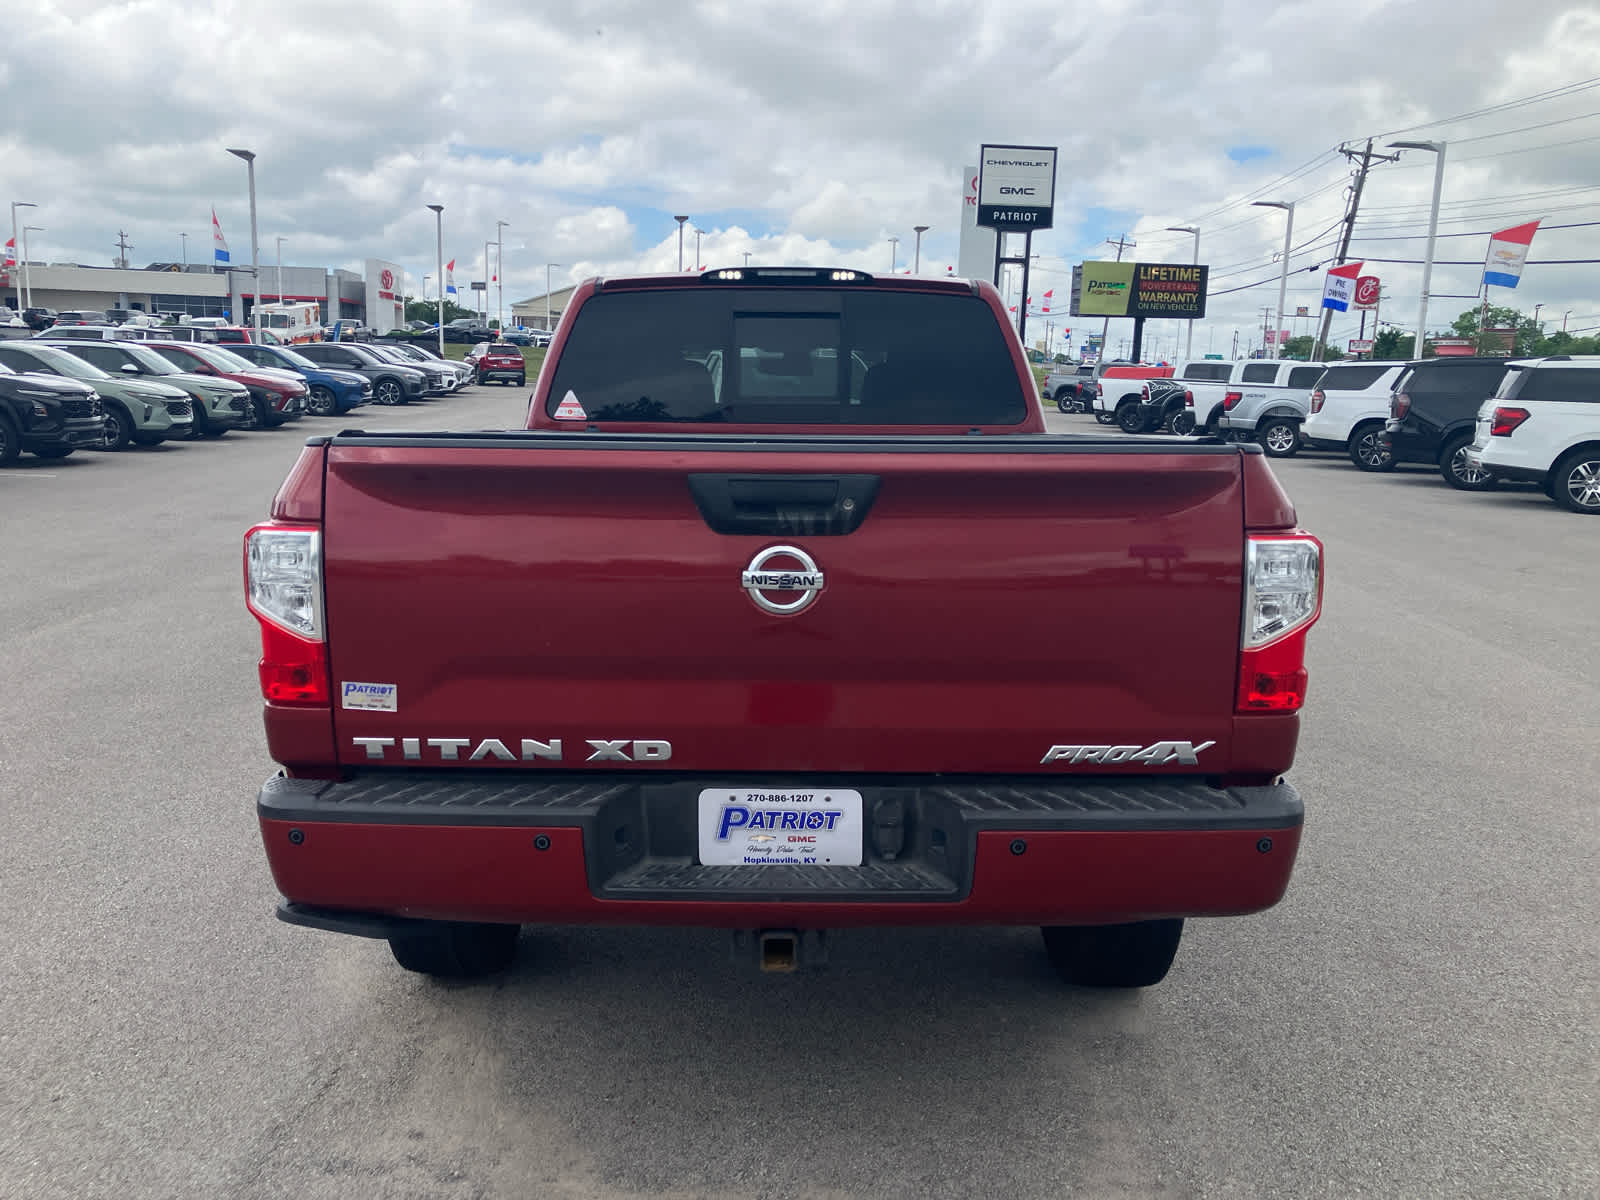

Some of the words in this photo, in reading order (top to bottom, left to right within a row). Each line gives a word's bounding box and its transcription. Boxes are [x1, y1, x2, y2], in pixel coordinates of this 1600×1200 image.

[986, 159, 1049, 167] CHEVROLET
[999, 187, 1036, 195] GMC
[993, 211, 1038, 221] PATRIOT
[1140, 266, 1201, 281] LIFETIME
[1138, 291, 1199, 303] WARRANTY
[1137, 302, 1150, 310] ON
[1150, 302, 1167, 310] NEW
[1167, 303, 1199, 311] VEHICLES
[751, 575, 816, 586] NISSAN
[344, 683, 393, 697] PATRIOT
[352, 737, 562, 761] TITAN
[585, 739, 673, 761] XD
[746, 794, 815, 802] 270-886-1207
[717, 805, 842, 841] PATRIOT
[787, 835, 817, 843] GMC
[743, 856, 802, 865] Hopkinsville,
